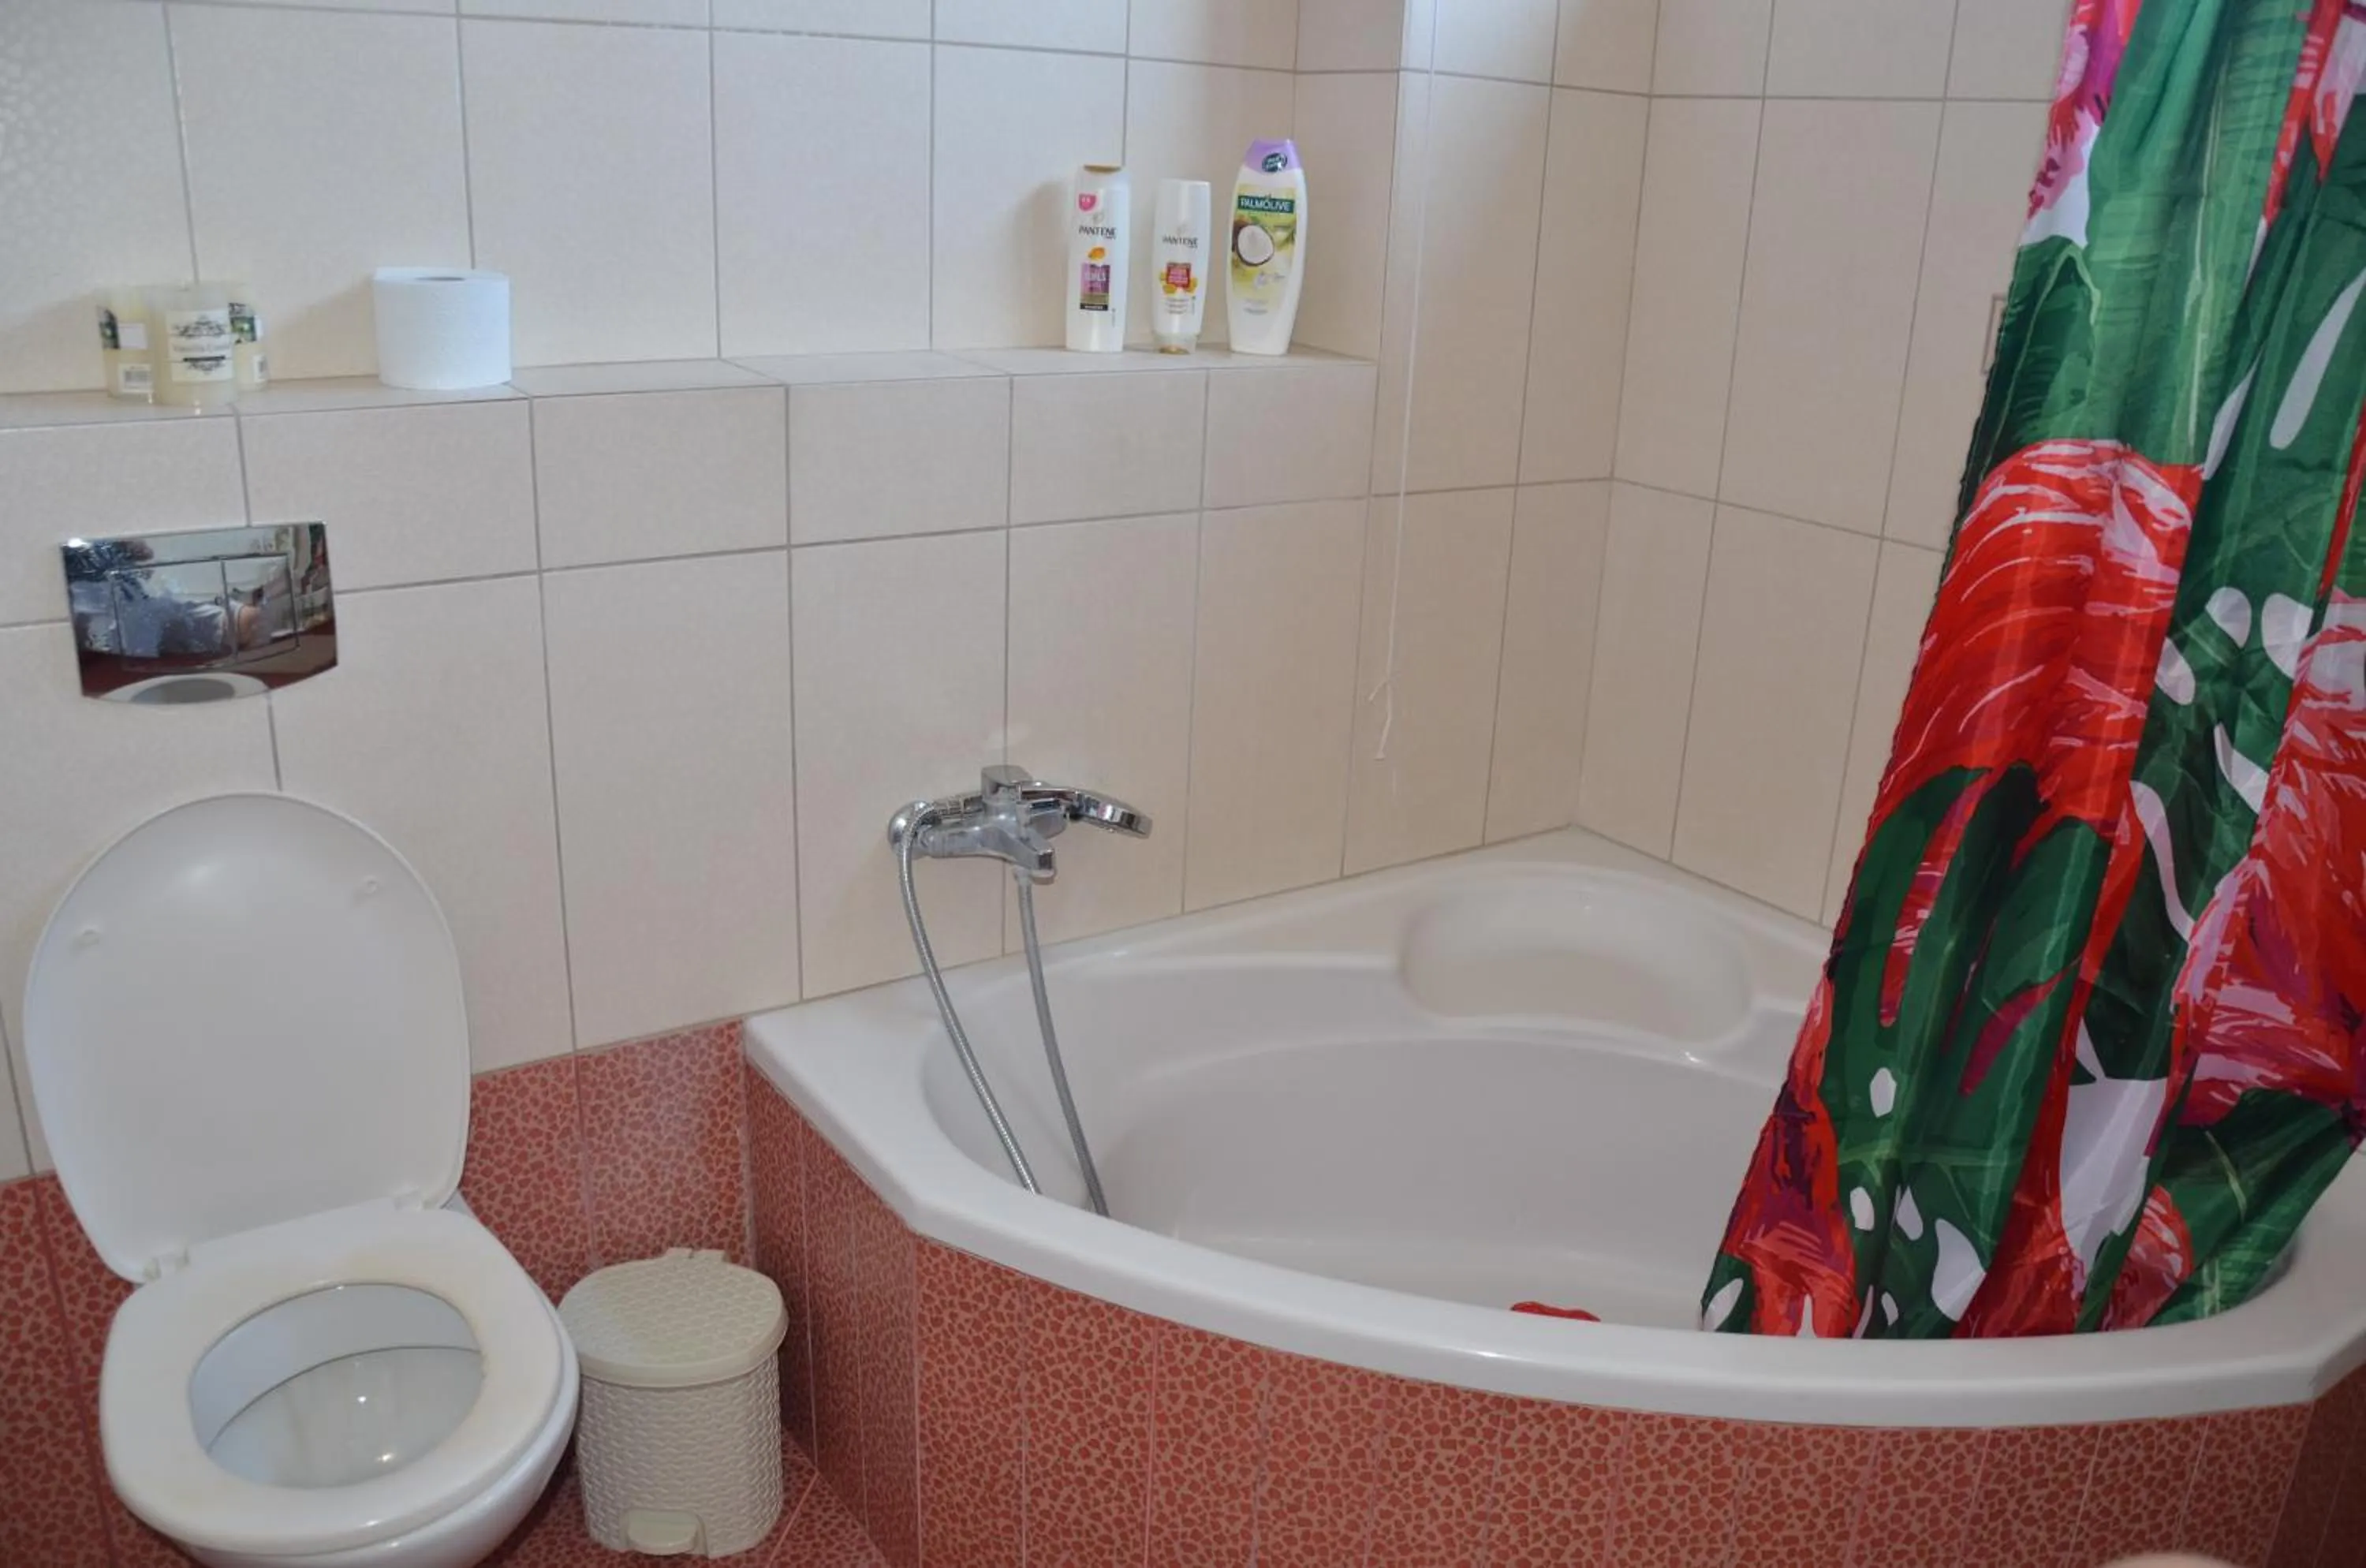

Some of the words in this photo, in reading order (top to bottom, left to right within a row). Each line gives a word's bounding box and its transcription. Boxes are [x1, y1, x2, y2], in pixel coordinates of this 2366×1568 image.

[1241, 197, 1292, 212] PALMOLIVE
[1078, 226, 1117, 237] PANTENE
[1162, 235, 1198, 245] PANTENE
